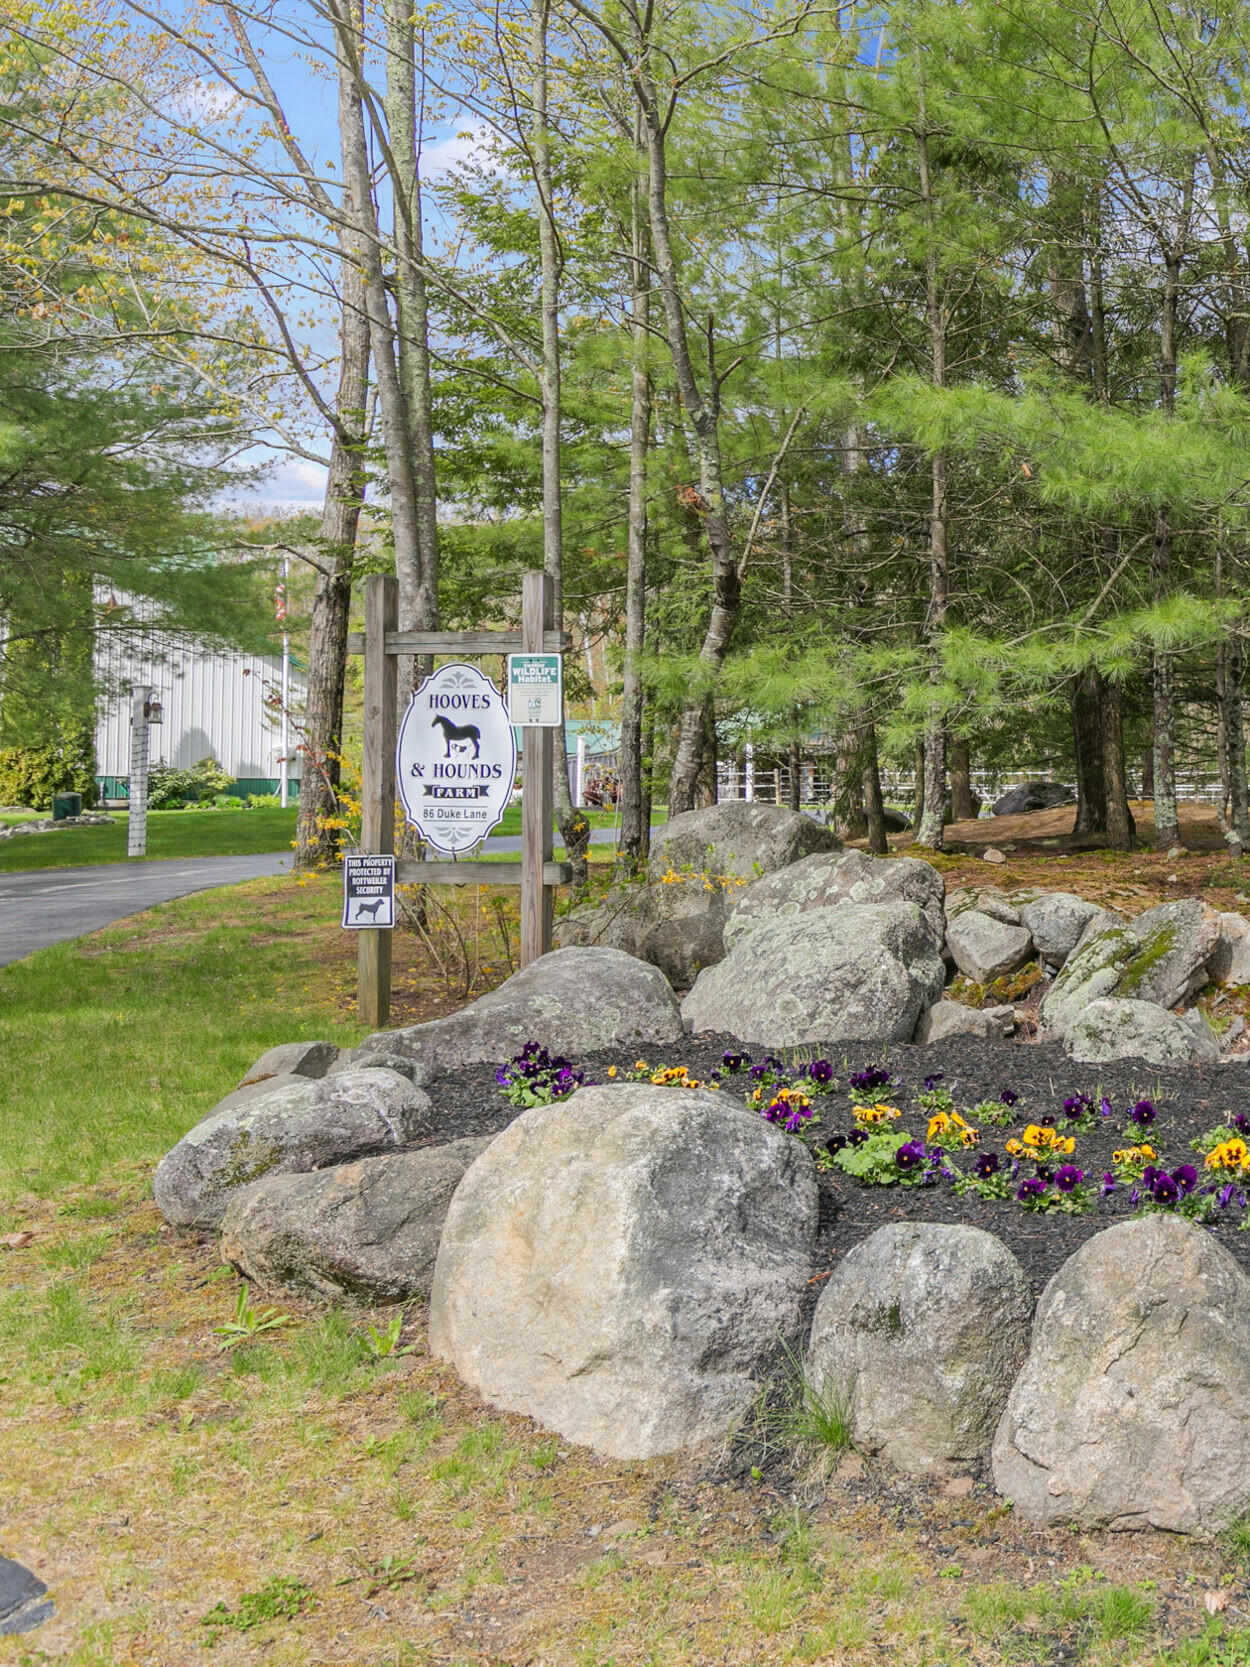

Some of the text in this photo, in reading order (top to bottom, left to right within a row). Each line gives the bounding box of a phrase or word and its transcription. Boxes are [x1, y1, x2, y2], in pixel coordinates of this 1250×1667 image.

[512, 667, 557, 676] WILDLIFE
[429, 694, 490, 709] HOOVES
[411, 762, 502, 779] & HOUNDS
[436, 788, 476, 798] FARM
[423, 809, 487, 819] 86 Duke Lane
[349, 858, 391, 867] THIS PROPERTY
[349, 867, 391, 876] PROTECTED BY
[352, 877, 387, 885] ROTTWEILER
[356, 886, 383, 894] SECURITY
